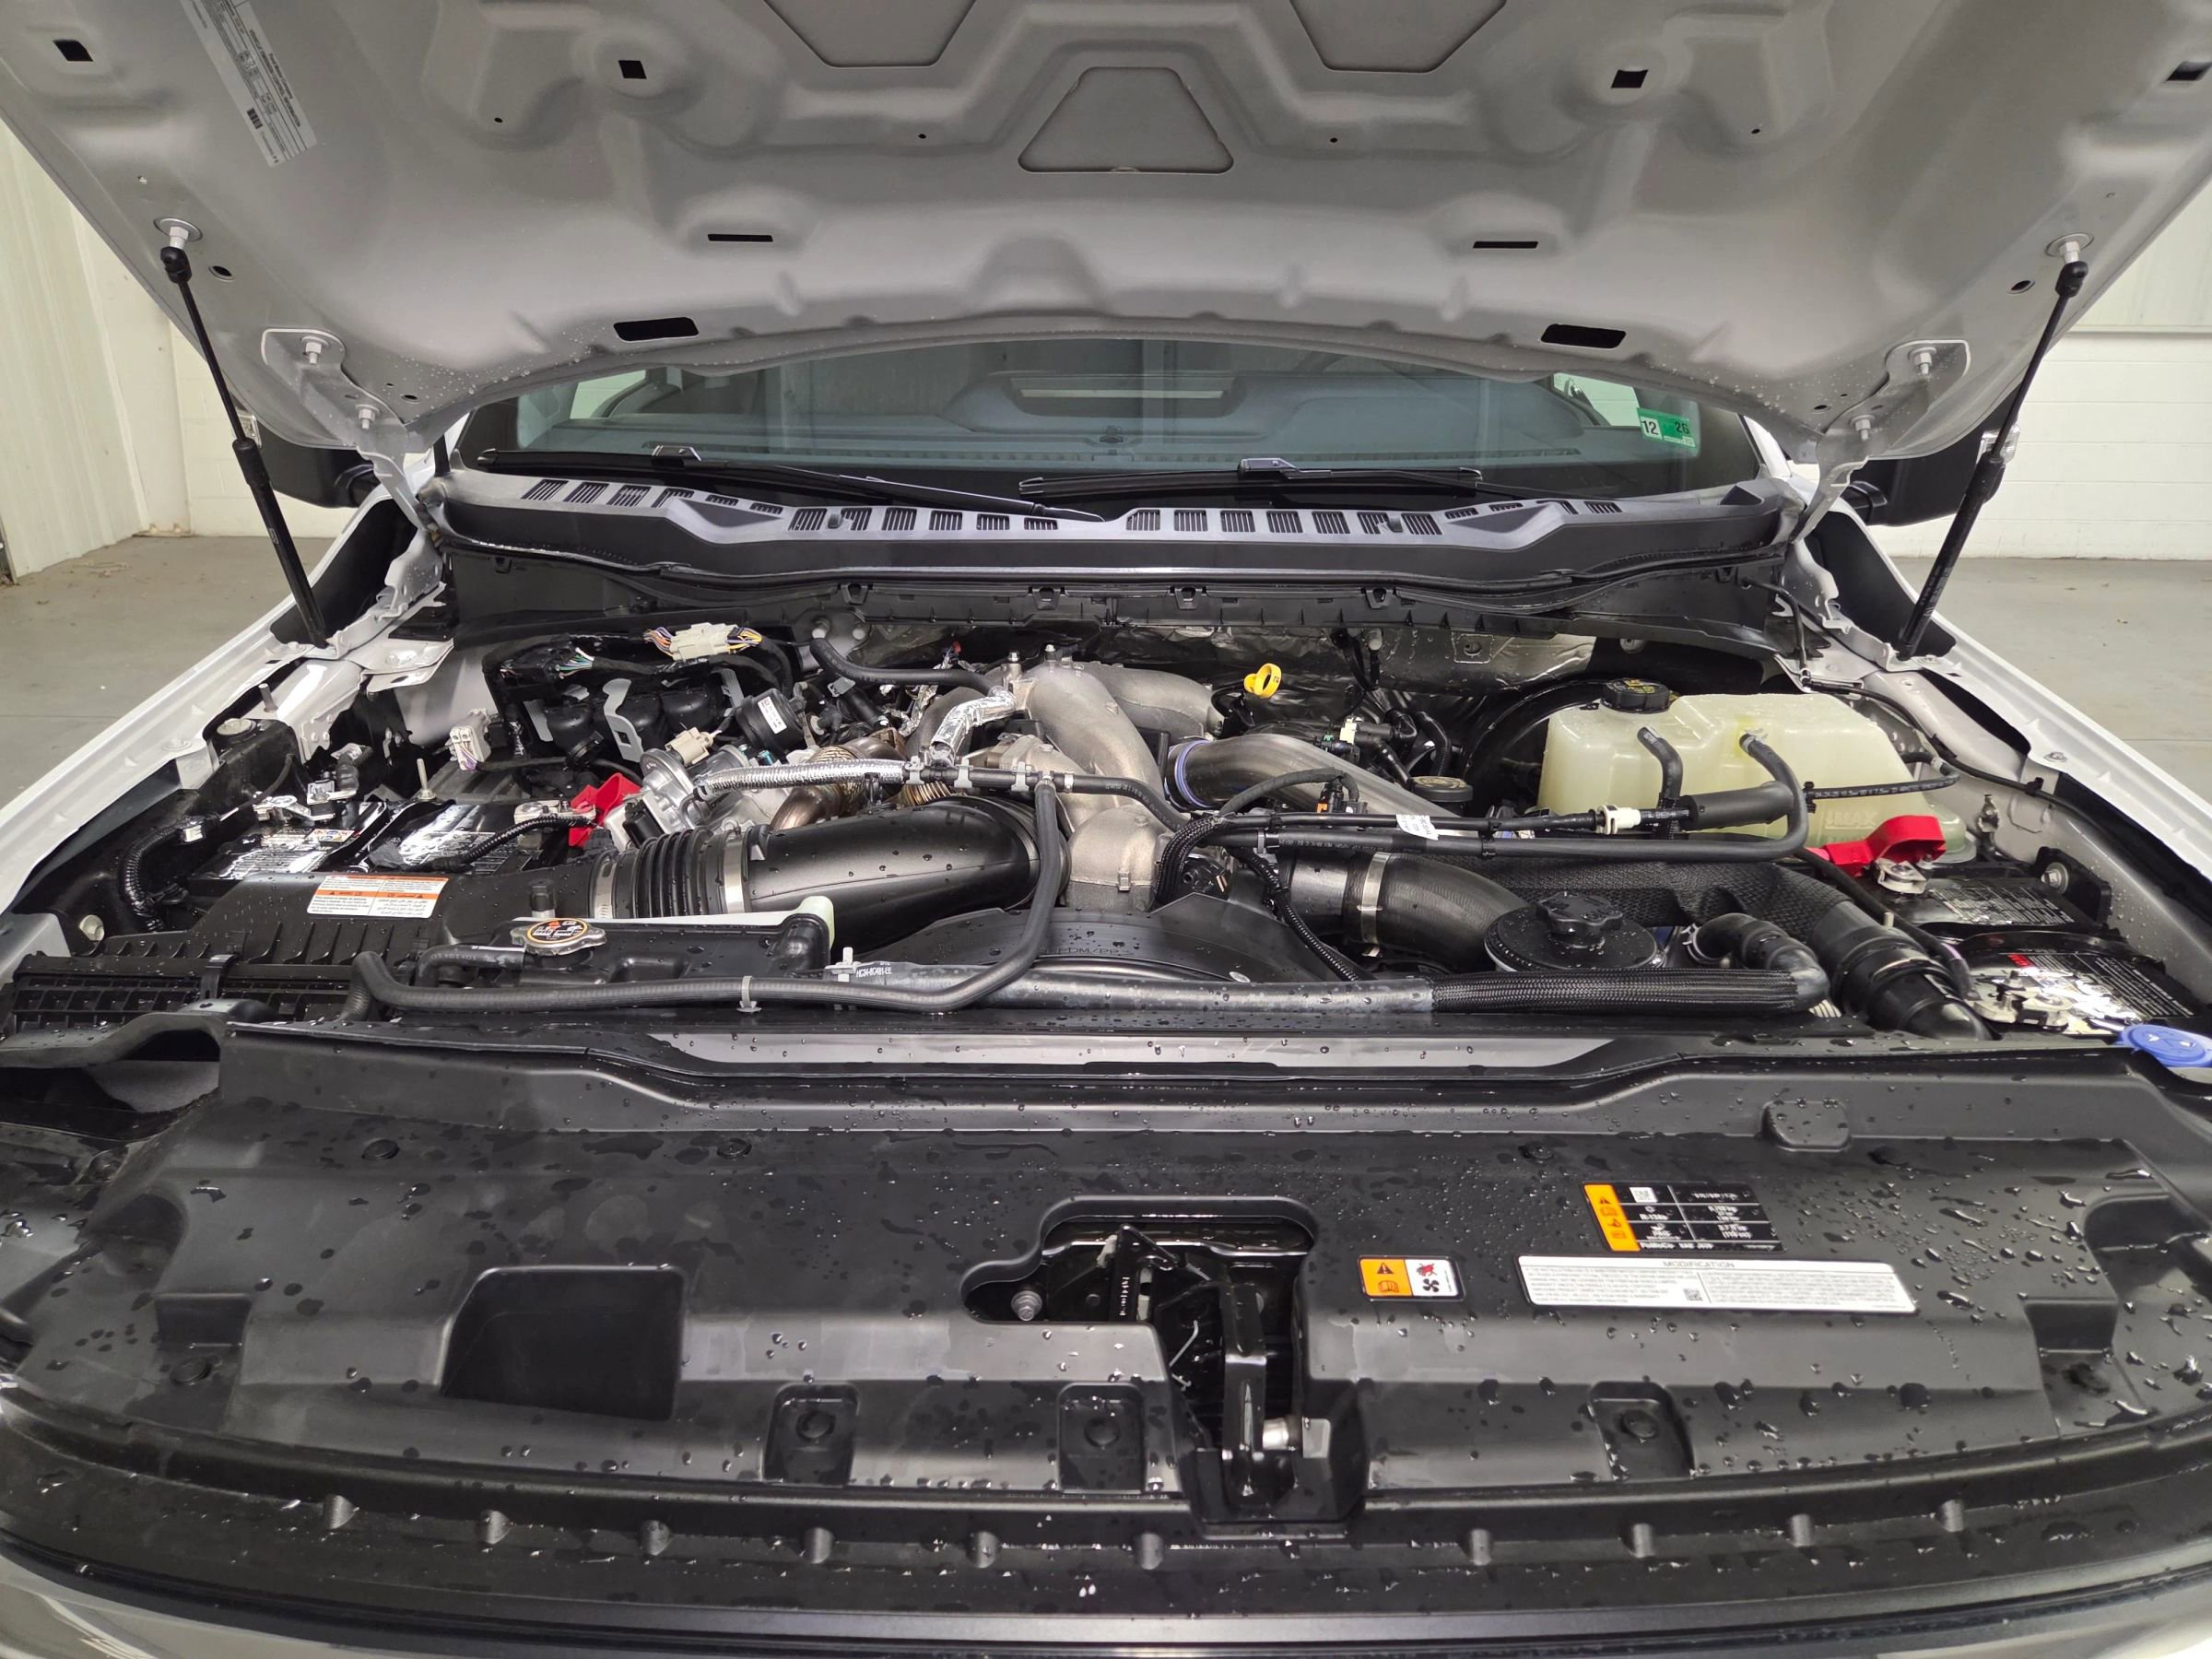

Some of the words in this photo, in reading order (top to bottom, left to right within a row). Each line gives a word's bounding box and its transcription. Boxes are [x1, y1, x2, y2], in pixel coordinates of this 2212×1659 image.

[1641, 420, 1659, 435] 12
[1675, 421, 1690, 435] 26
[1663, 1260, 1735, 1268] MODIFICATION
